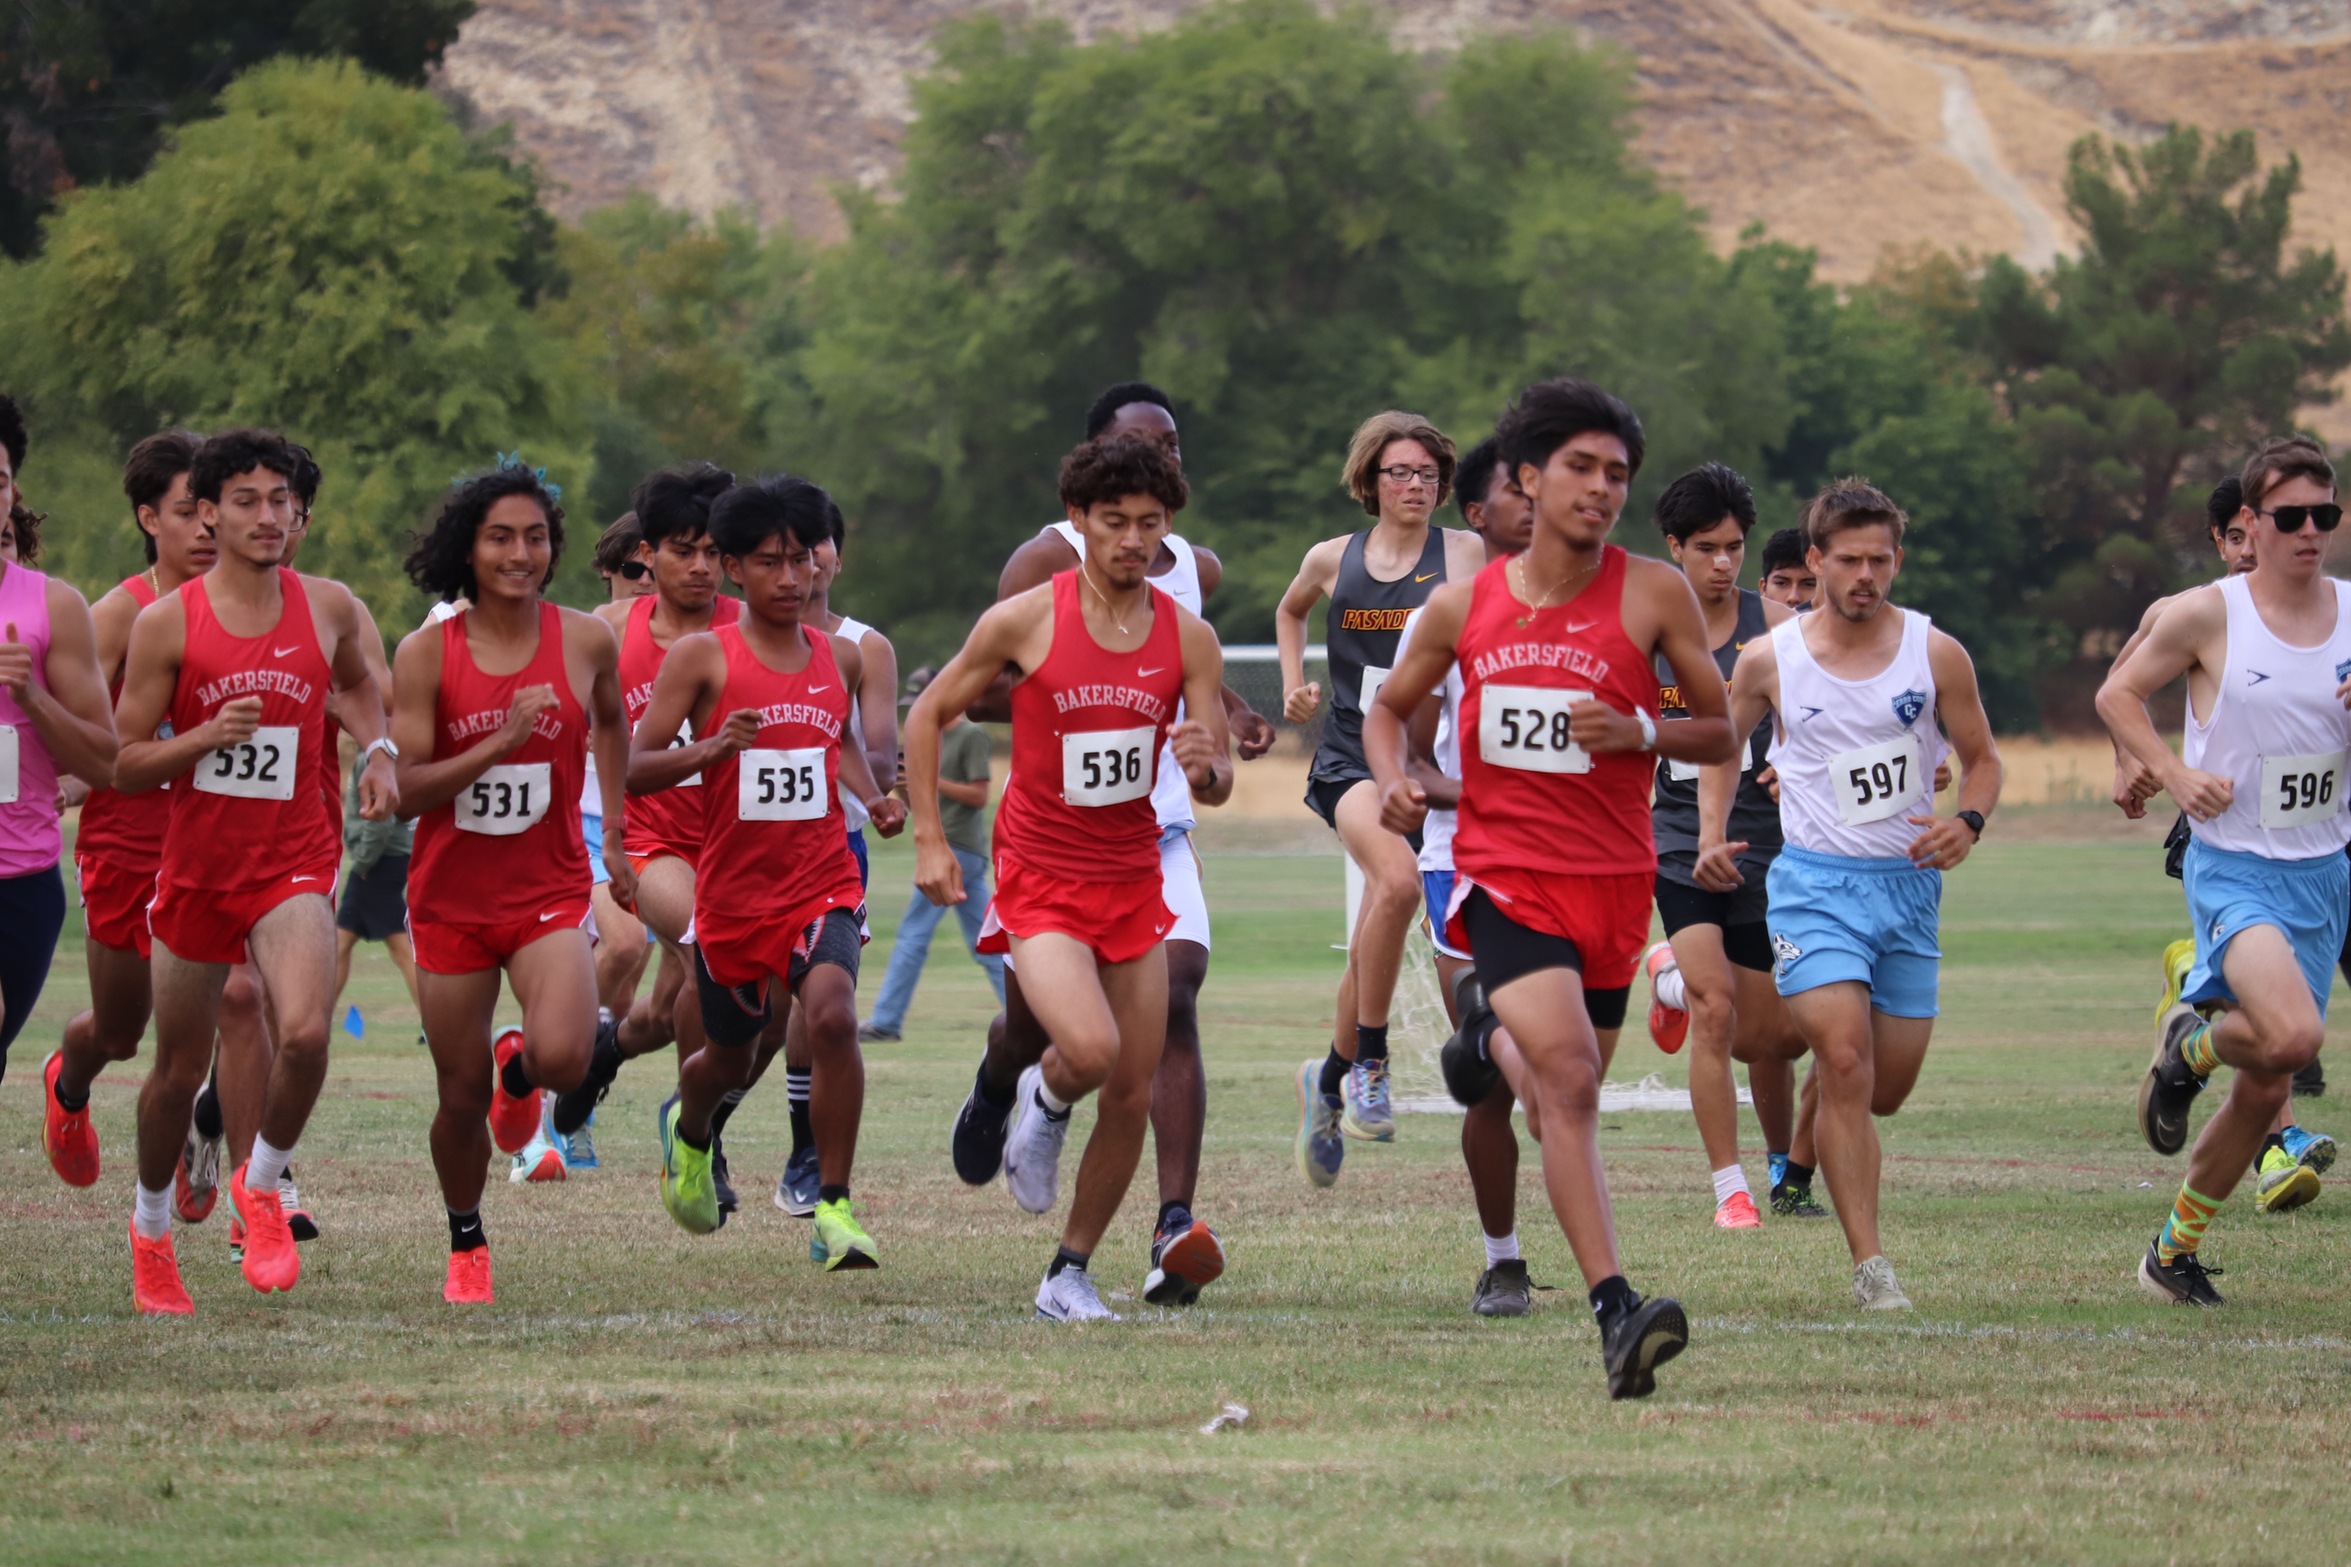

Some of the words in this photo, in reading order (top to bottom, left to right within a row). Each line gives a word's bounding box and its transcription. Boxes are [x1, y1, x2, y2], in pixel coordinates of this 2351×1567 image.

[1341, 608, 1418, 631] PASAD
[1474, 642, 1610, 684] BAKERSFIELD
[196, 668, 312, 707] BAKERSFIELD
[756, 703, 841, 739] KERSFIELD
[1500, 708, 1571, 752] 528
[214, 743, 280, 782] 532
[1082, 747, 1141, 790] 536
[1849, 754, 1907, 806] 597
[471, 782, 531, 818] 531
[757, 766, 815, 804] 535
[2280, 769, 2335, 812] 596
